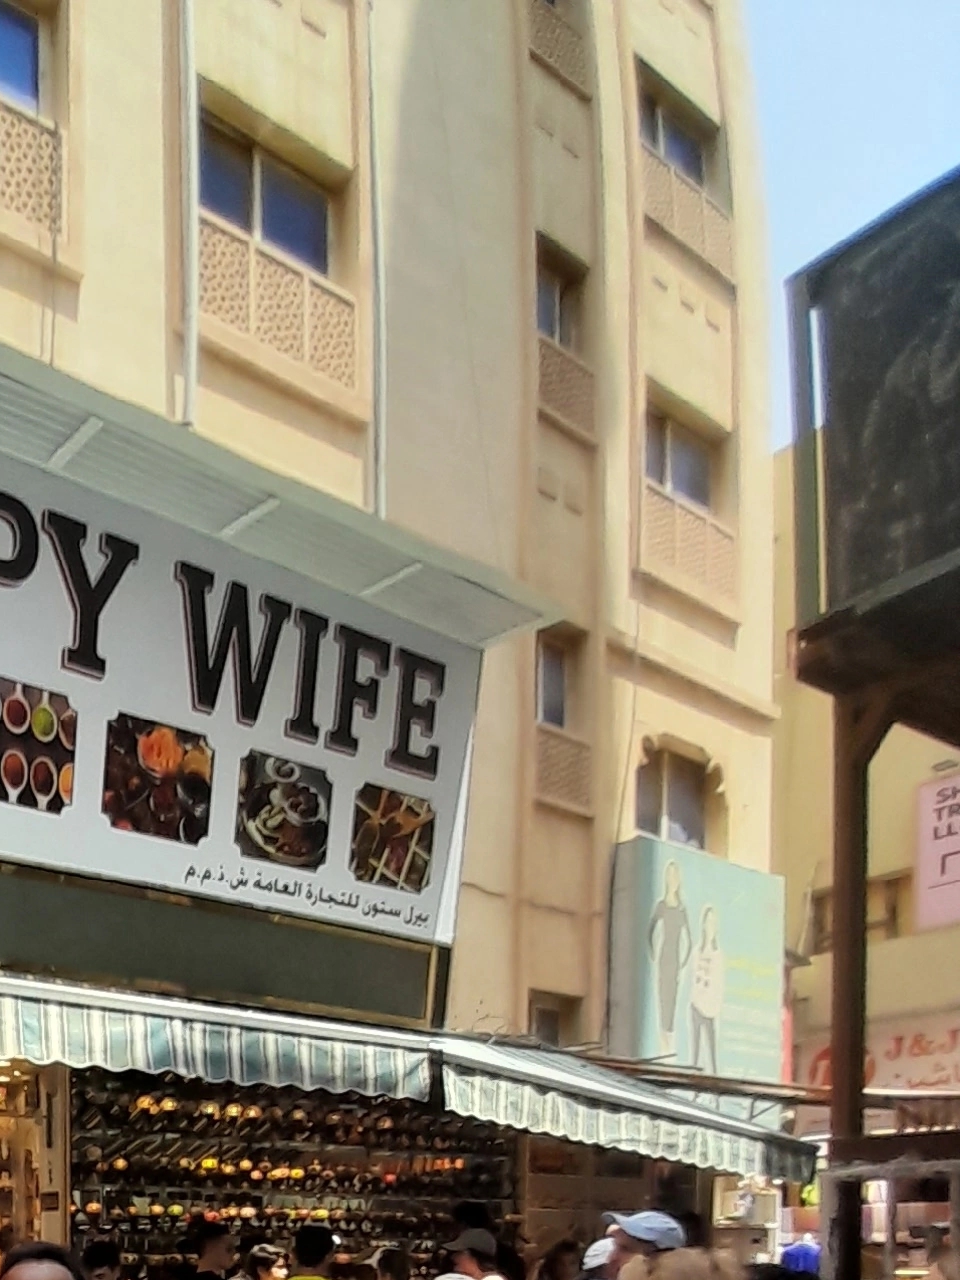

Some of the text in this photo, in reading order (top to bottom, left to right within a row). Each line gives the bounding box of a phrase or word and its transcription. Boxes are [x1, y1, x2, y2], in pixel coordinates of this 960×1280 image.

[174, 560, 447, 782] WIFE
[252, 872, 303, 898] العامة
[304, 884, 360, 909] للتجارة
